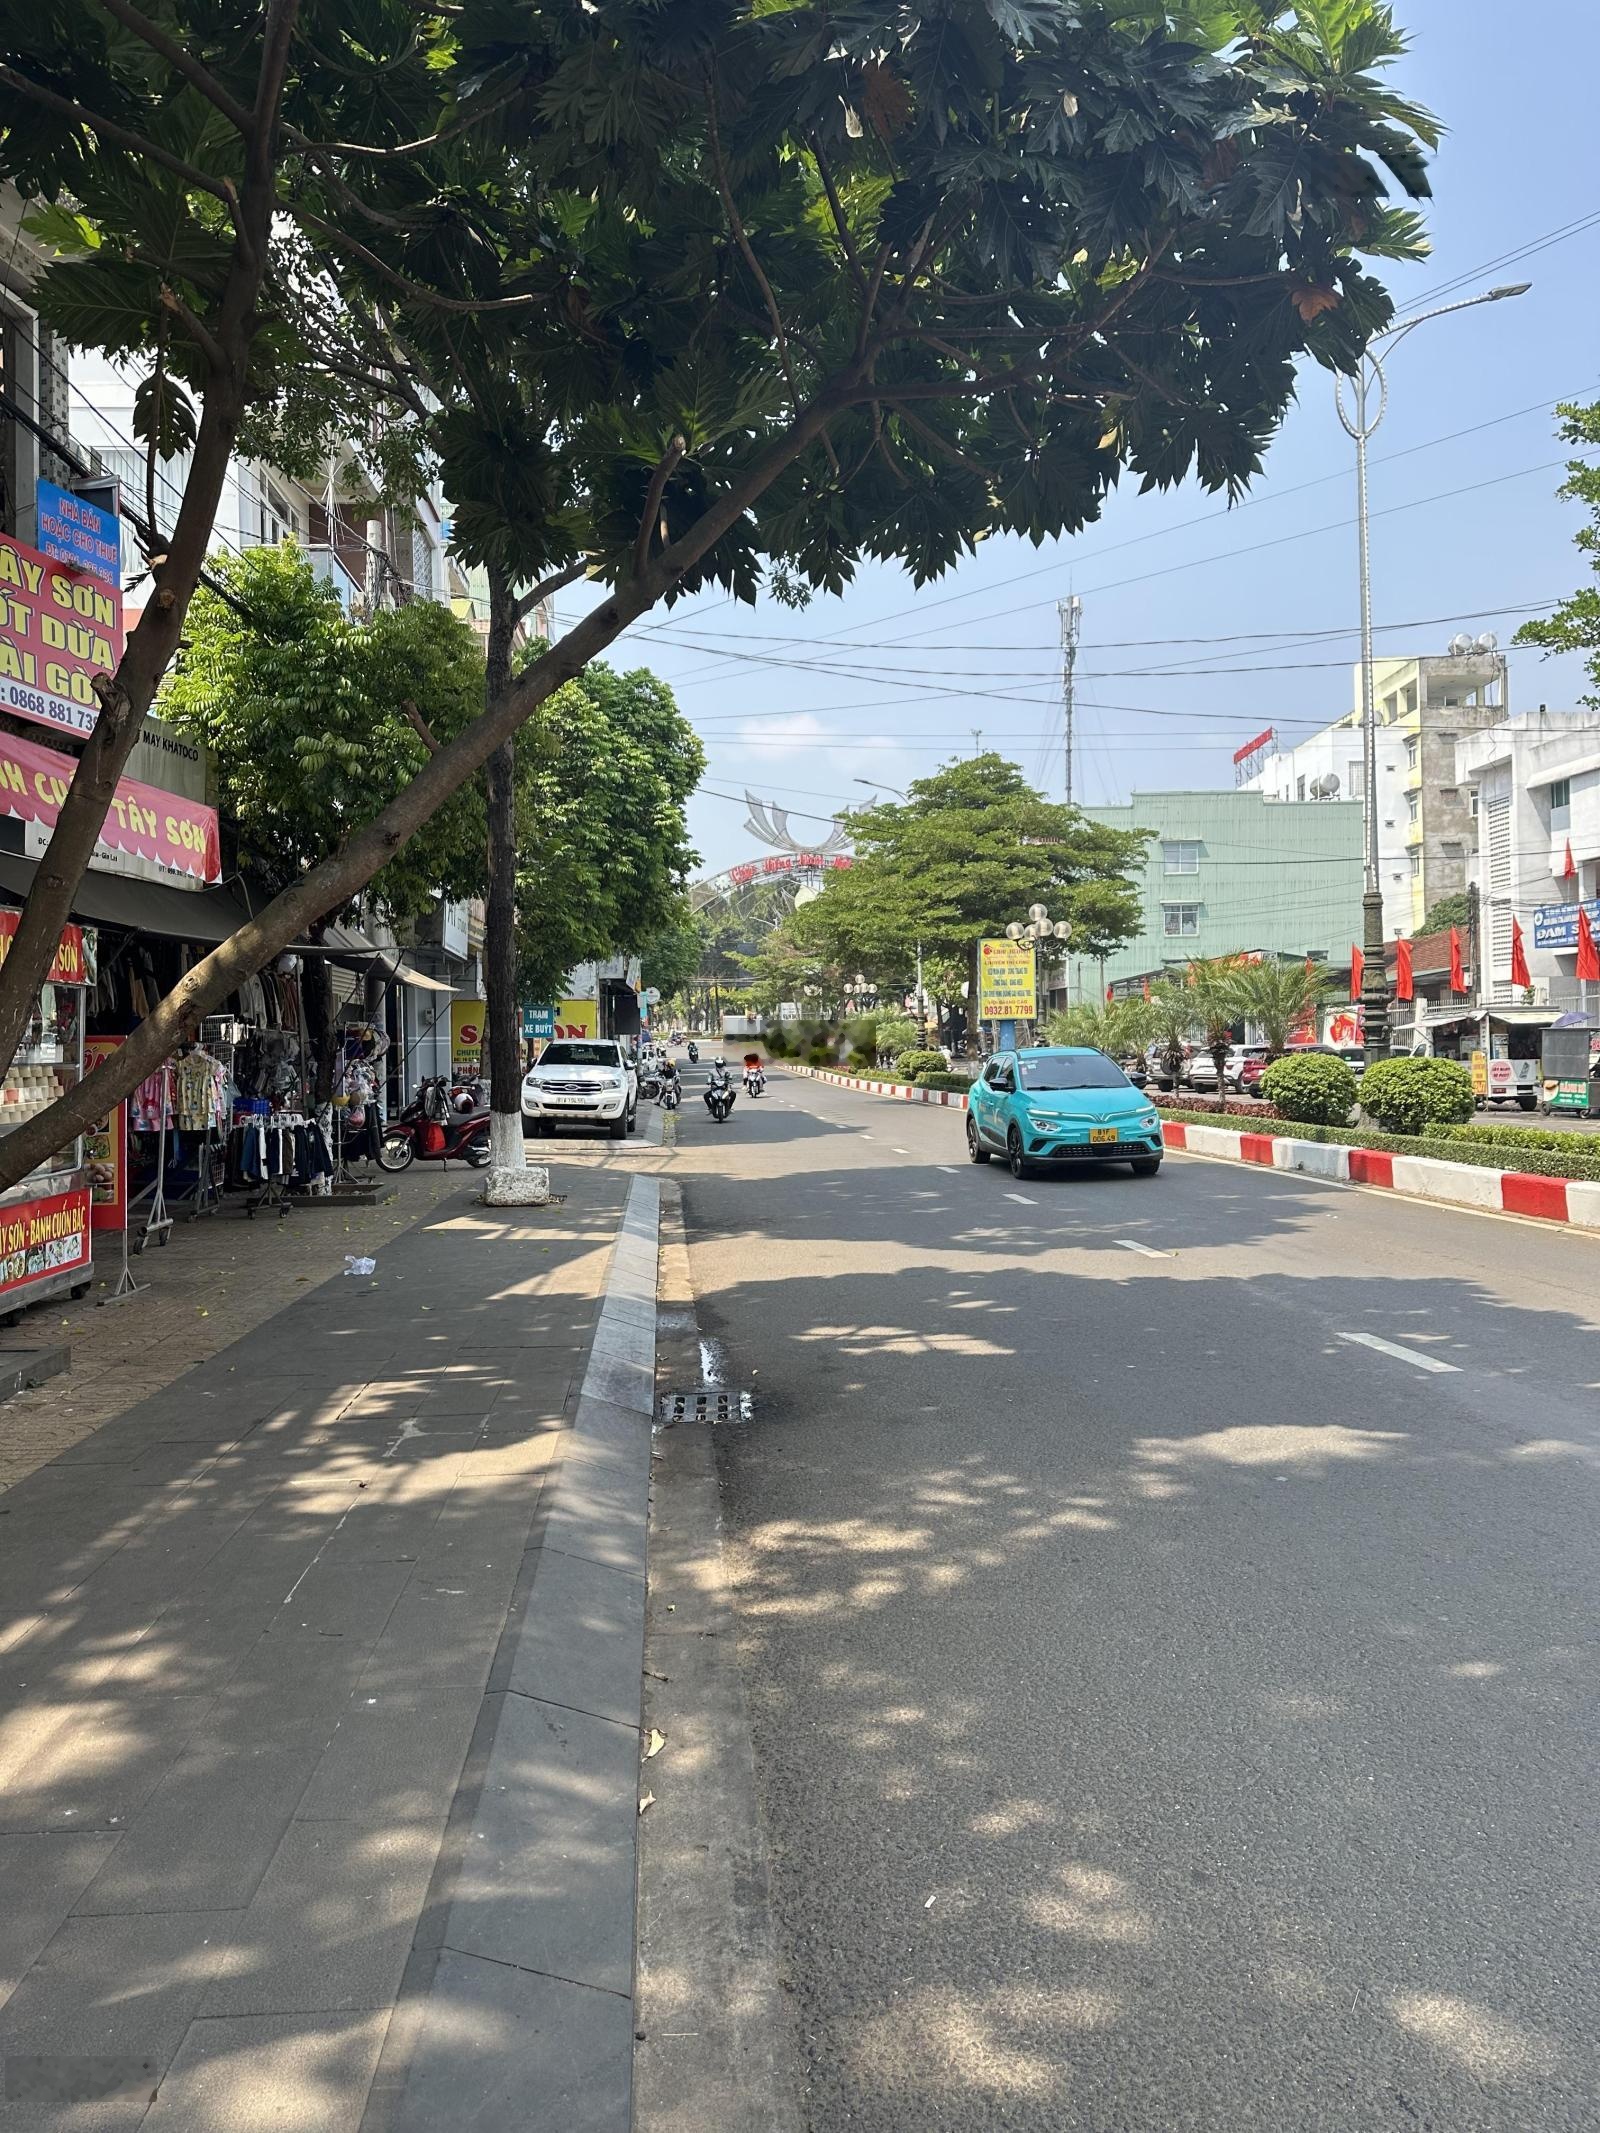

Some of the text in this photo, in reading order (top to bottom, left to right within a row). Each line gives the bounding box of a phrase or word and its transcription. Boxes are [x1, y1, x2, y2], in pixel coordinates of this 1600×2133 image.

[59, 499, 80, 523] NHÀ
[41, 512, 71, 543] HOẶC
[72, 529, 94, 553] CHO
[95, 539, 118, 565] THUÊ
[51, 574, 116, 629] SƠN
[41, 612, 116, 672] DỪA
[9, 686, 45, 715] 0868
[48, 700, 73, 725] 881
[143, 730, 200, 762] MAY KHATOCO
[111, 795, 157, 839] TÂY
[165, 815, 206, 855] SƠN
[58, 939, 78, 973] SƠN
[524, 1022, 553, 1034] XE BUÝT
[528, 1009, 549, 1021] TRẠM
[984, 1005, 1033, 1015] 0932.81.7799
[8, 1218, 26, 1252] SƠN
[30, 1209, 51, 1245] BÁNH
[52, 1199, 72, 1238] CUỐN
